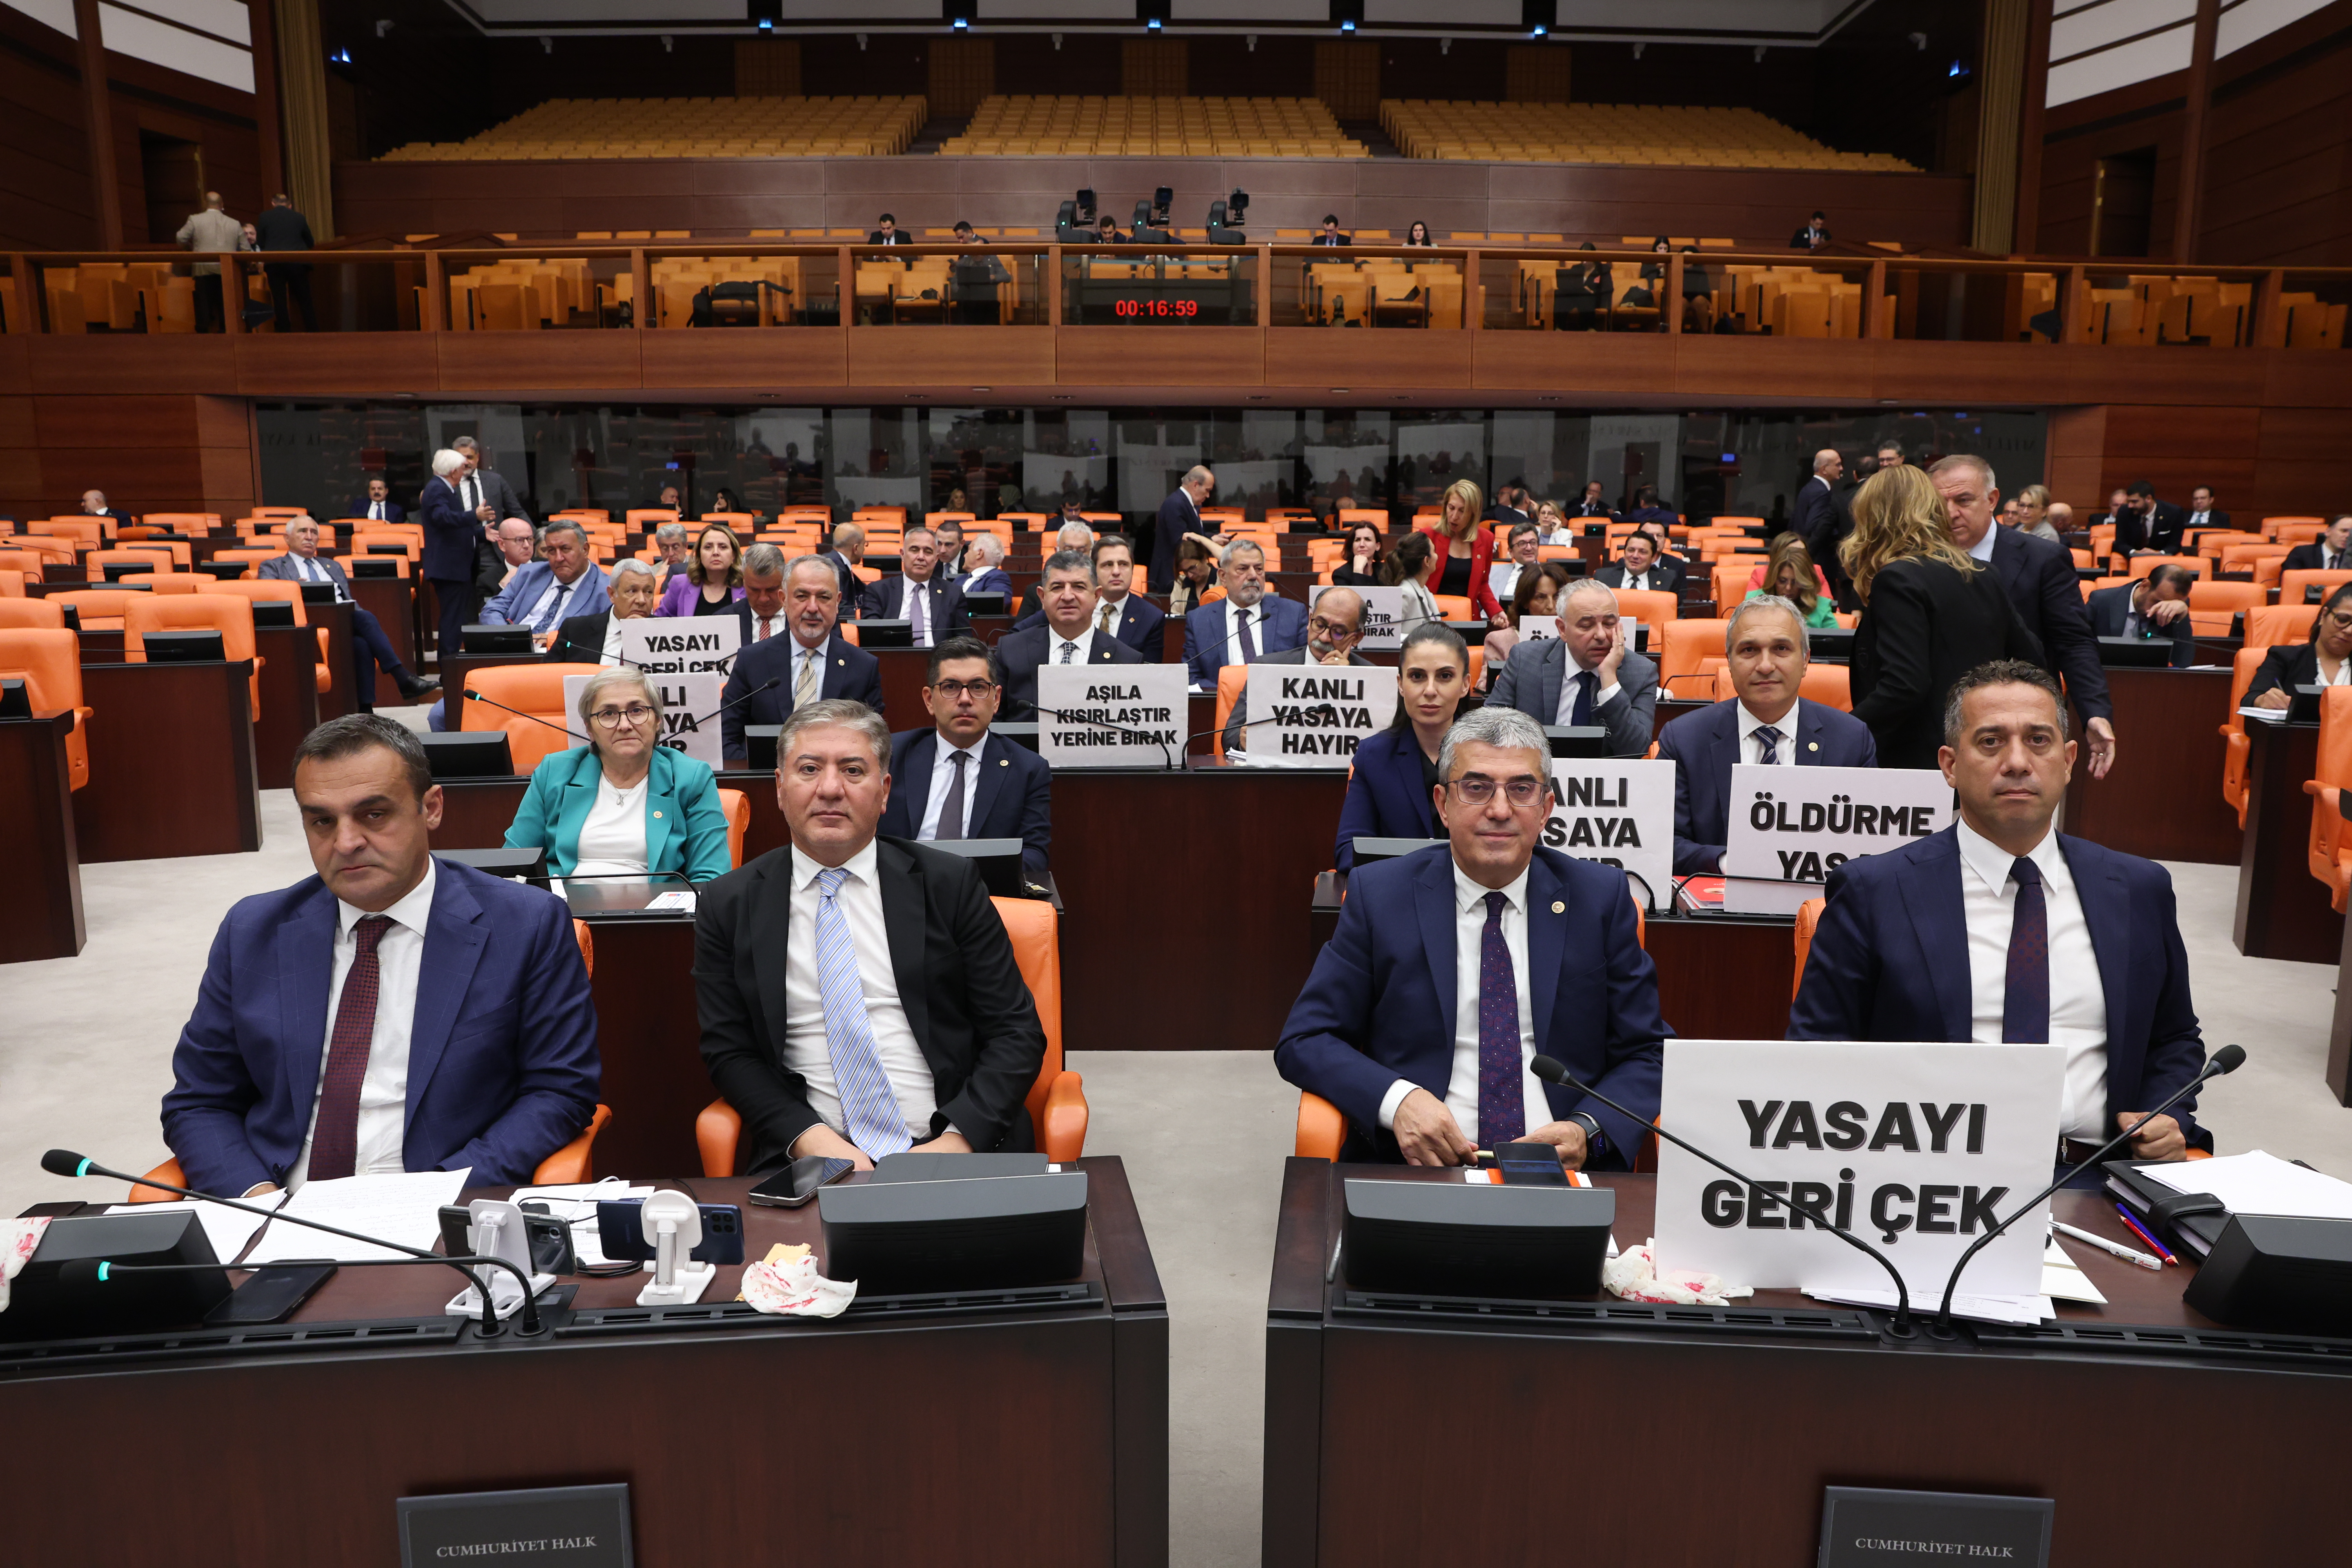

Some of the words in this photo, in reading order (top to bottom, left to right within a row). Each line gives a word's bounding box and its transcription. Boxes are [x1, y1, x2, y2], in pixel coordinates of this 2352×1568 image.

[1116, 300, 1198, 316] 00:16:59
[644, 634, 719, 652] YASAYI
[1086, 685, 1142, 704] AŞILA
[1282, 678, 1364, 701] KANLI
[1056, 707, 1171, 726] KISIRLAŞTIR
[1271, 705, 1373, 728] YASAYA
[1051, 727, 1117, 746] YERİNE
[1121, 729, 1177, 746] BIRAK
[1282, 733, 1360, 755] HAYIR
[1550, 777, 1628, 808] ANLI
[1750, 792, 1934, 837] ÖLDÜRME
[1536, 817, 1642, 848] SAYA
[1737, 1100, 1987, 1154] YASAYI
[1701, 1168, 1855, 1231] GERİ
[1870, 1183, 2011, 1244] ÇEK
[436, 1539, 548, 1557] CUMHURİYET
[552, 1536, 597, 1549] HALK
[1855, 1538, 1965, 1555] CUMHURİYET
[1969, 1545, 2013, 1558] HALK
